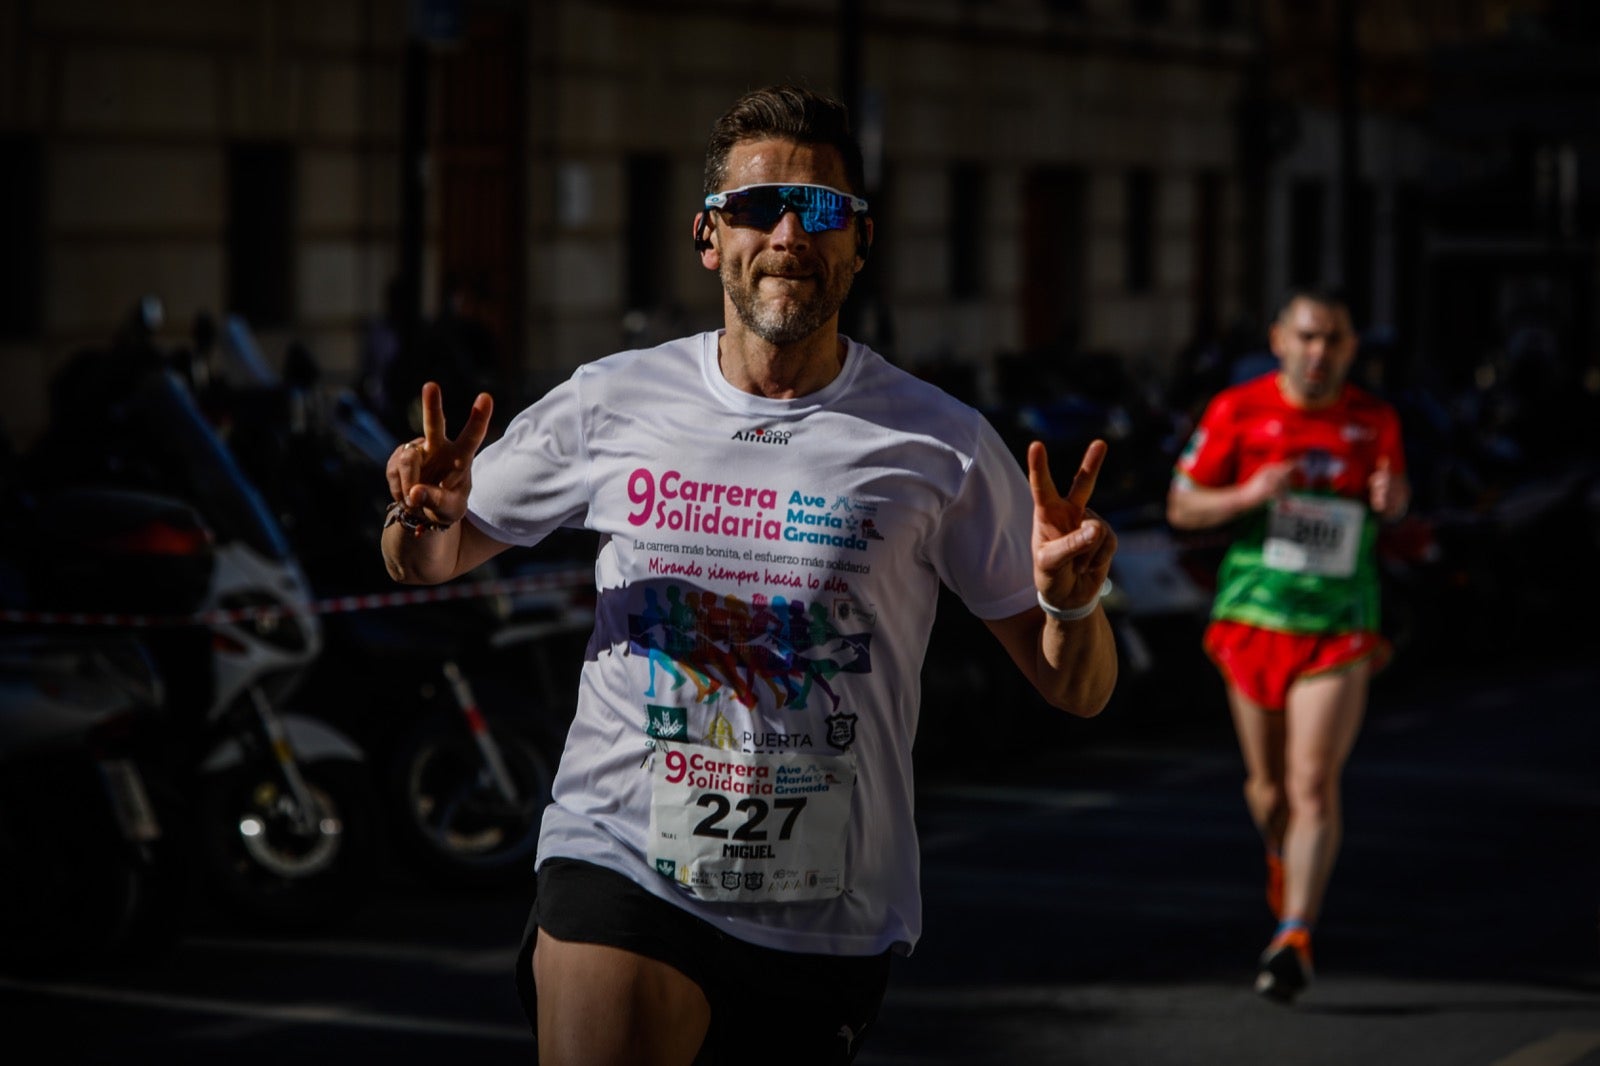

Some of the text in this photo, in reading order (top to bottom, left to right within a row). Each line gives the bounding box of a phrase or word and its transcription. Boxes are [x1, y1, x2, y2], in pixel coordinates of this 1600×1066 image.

[627, 468, 777, 526] 9 Carrera
[788, 490, 826, 508] Ave
[655, 500, 782, 541] Solidaria
[786, 508, 843, 529] María
[783, 526, 868, 551] Granada
[646, 541, 680, 553] carrera
[681, 543, 704, 556] más
[706, 545, 741, 560] bonita,
[743, 549, 753, 561] el
[754, 551, 800, 565] esfuerzo
[801, 557, 824, 568] más
[648, 556, 849, 594] Mirando siempre hacia lo alto
[743, 731, 813, 748] PUERTA
[665, 750, 769, 784] 9 Carrera
[776, 765, 801, 774] Ave
[776, 775, 812, 784] María
[687, 771, 773, 796] Solidaria
[775, 784, 829, 794] Granada
[692, 793, 808, 841] 227
[722, 843, 776, 859] MIGUEL
